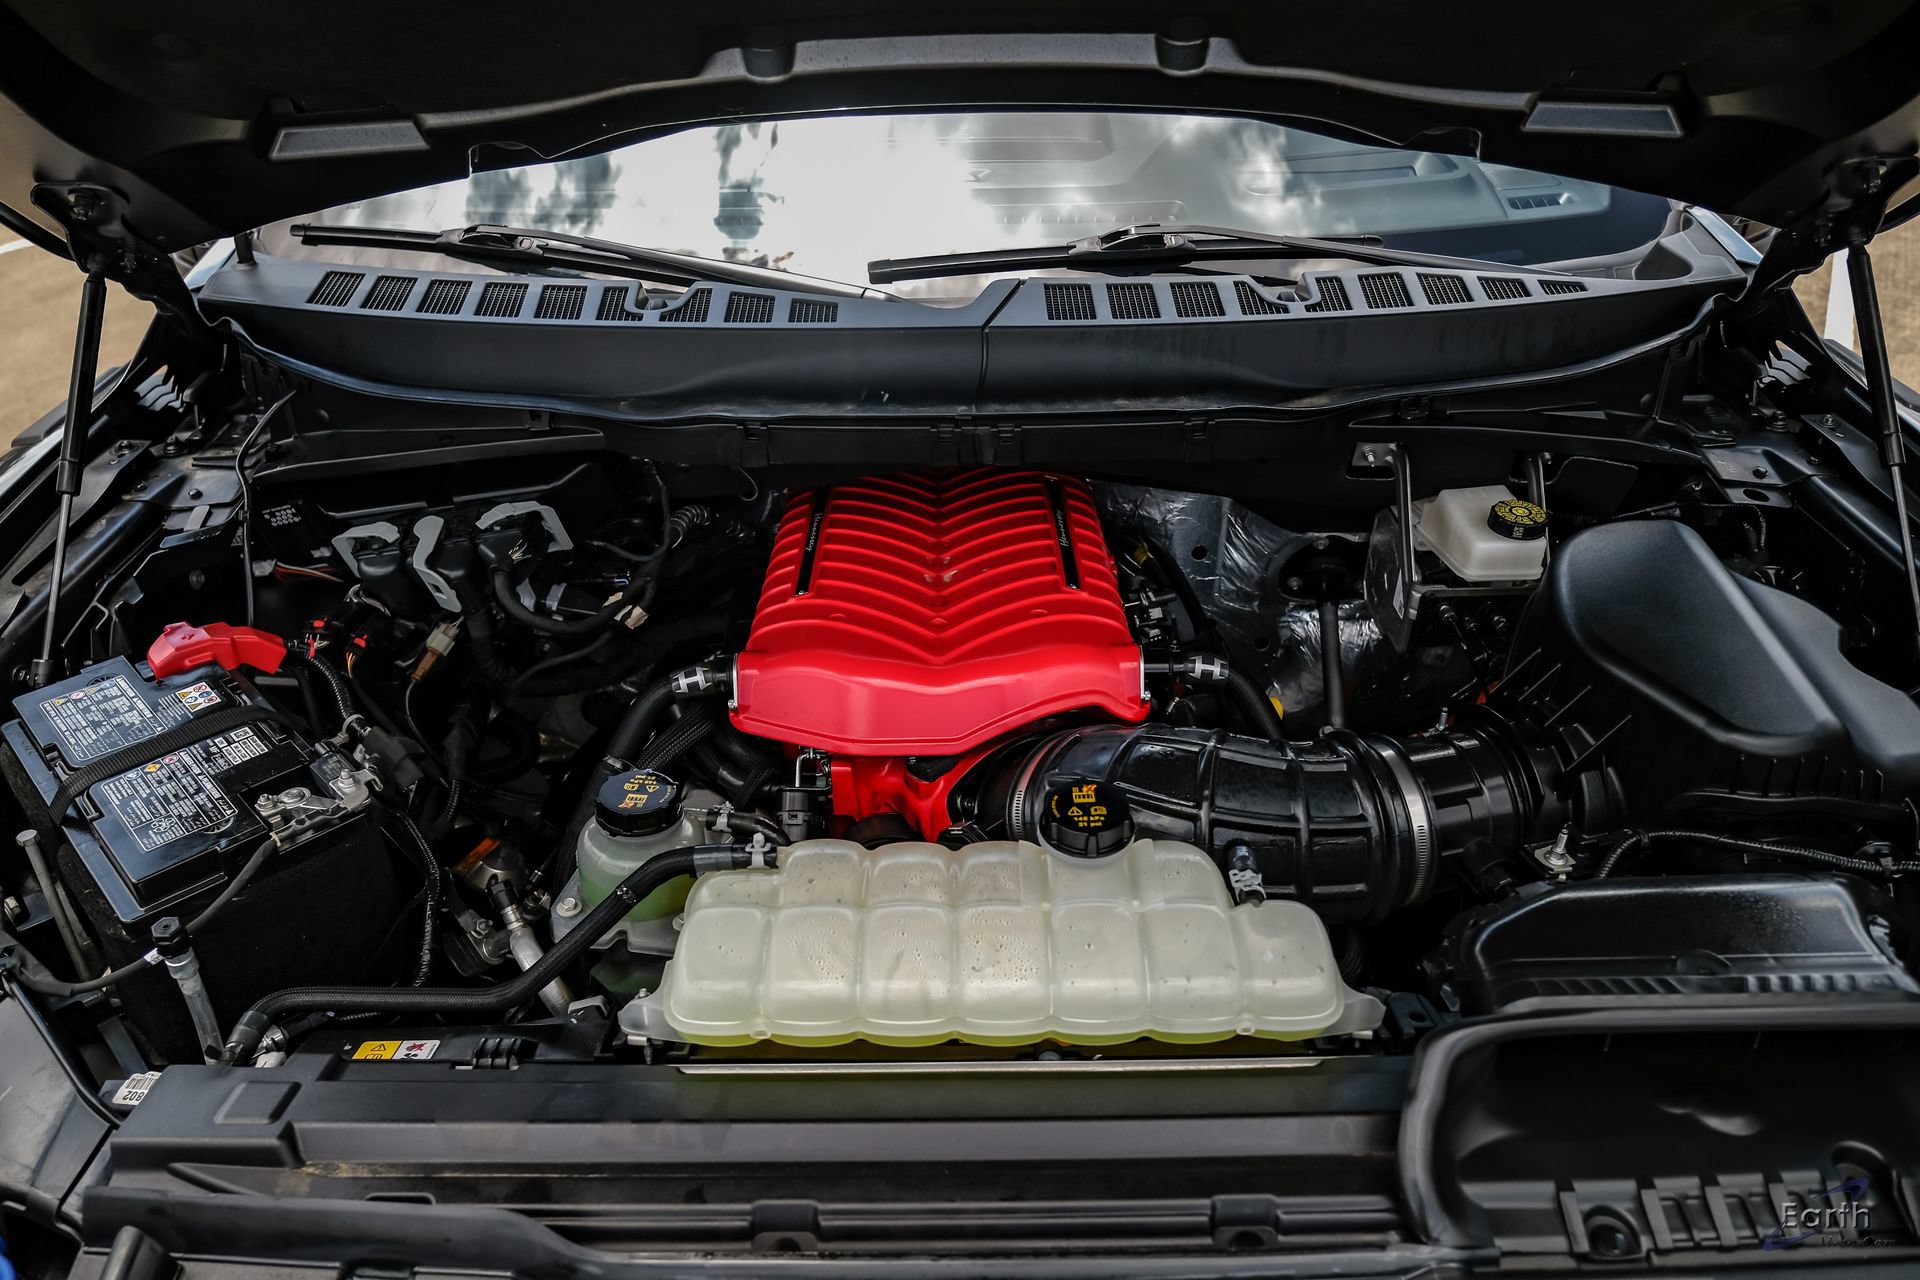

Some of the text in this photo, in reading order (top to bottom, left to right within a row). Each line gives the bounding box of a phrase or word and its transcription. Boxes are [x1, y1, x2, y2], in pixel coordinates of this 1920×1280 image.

[1055, 508, 1070, 547] Hennessey
[672, 666, 712, 693] H
[1188, 655, 1227, 680] H
[122, 1090, 145, 1101] 802
